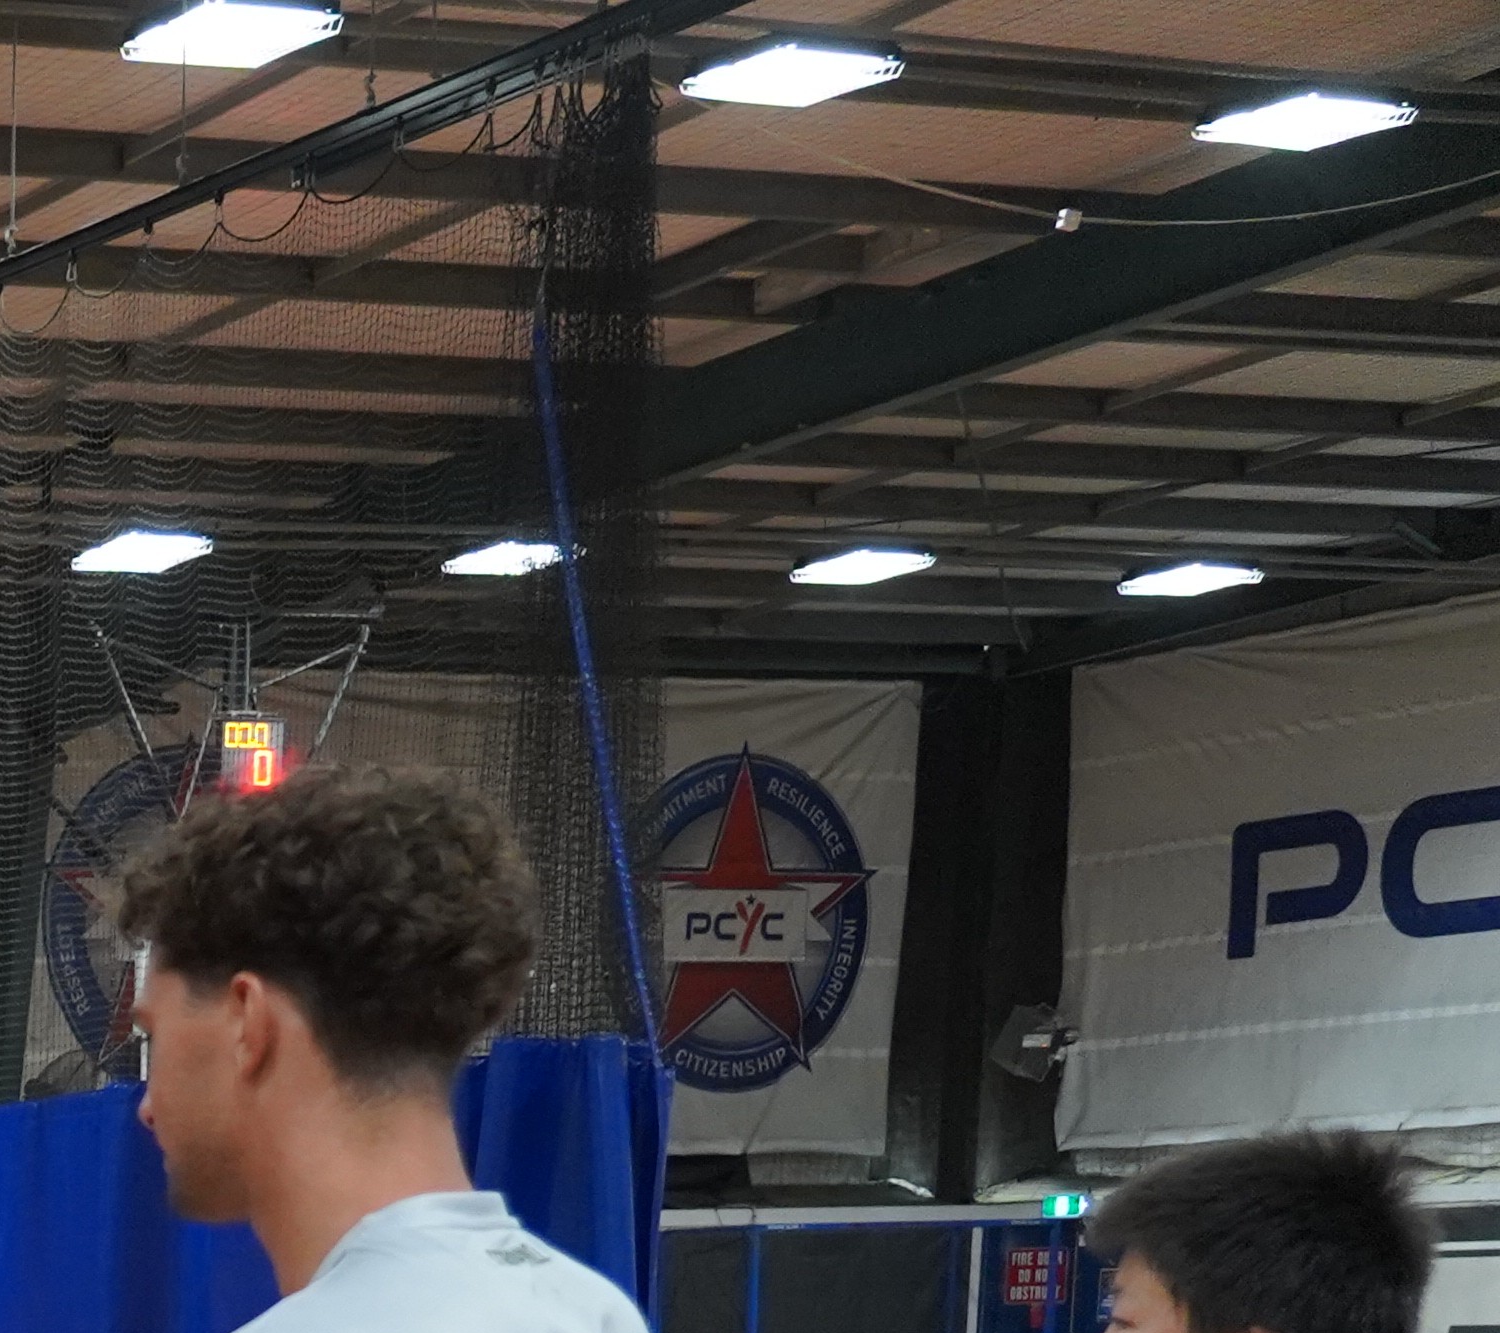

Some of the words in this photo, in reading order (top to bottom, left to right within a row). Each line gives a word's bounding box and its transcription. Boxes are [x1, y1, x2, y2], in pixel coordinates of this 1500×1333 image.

[253, 750, 274, 787] 0
[767, 778, 845, 860] RESILIENCE
[686, 902, 784, 956] PCYC
[818, 919, 858, 1020] INTEGRITY
[675, 1046, 786, 1079] CITIZENSHIP
[1011, 1251, 1034, 1266] FIRE
[1018, 1269, 1031, 1283] DO
[1035, 1269, 1049, 1283] NO
[1010, 1286, 1062, 1300] OBSTRUT
